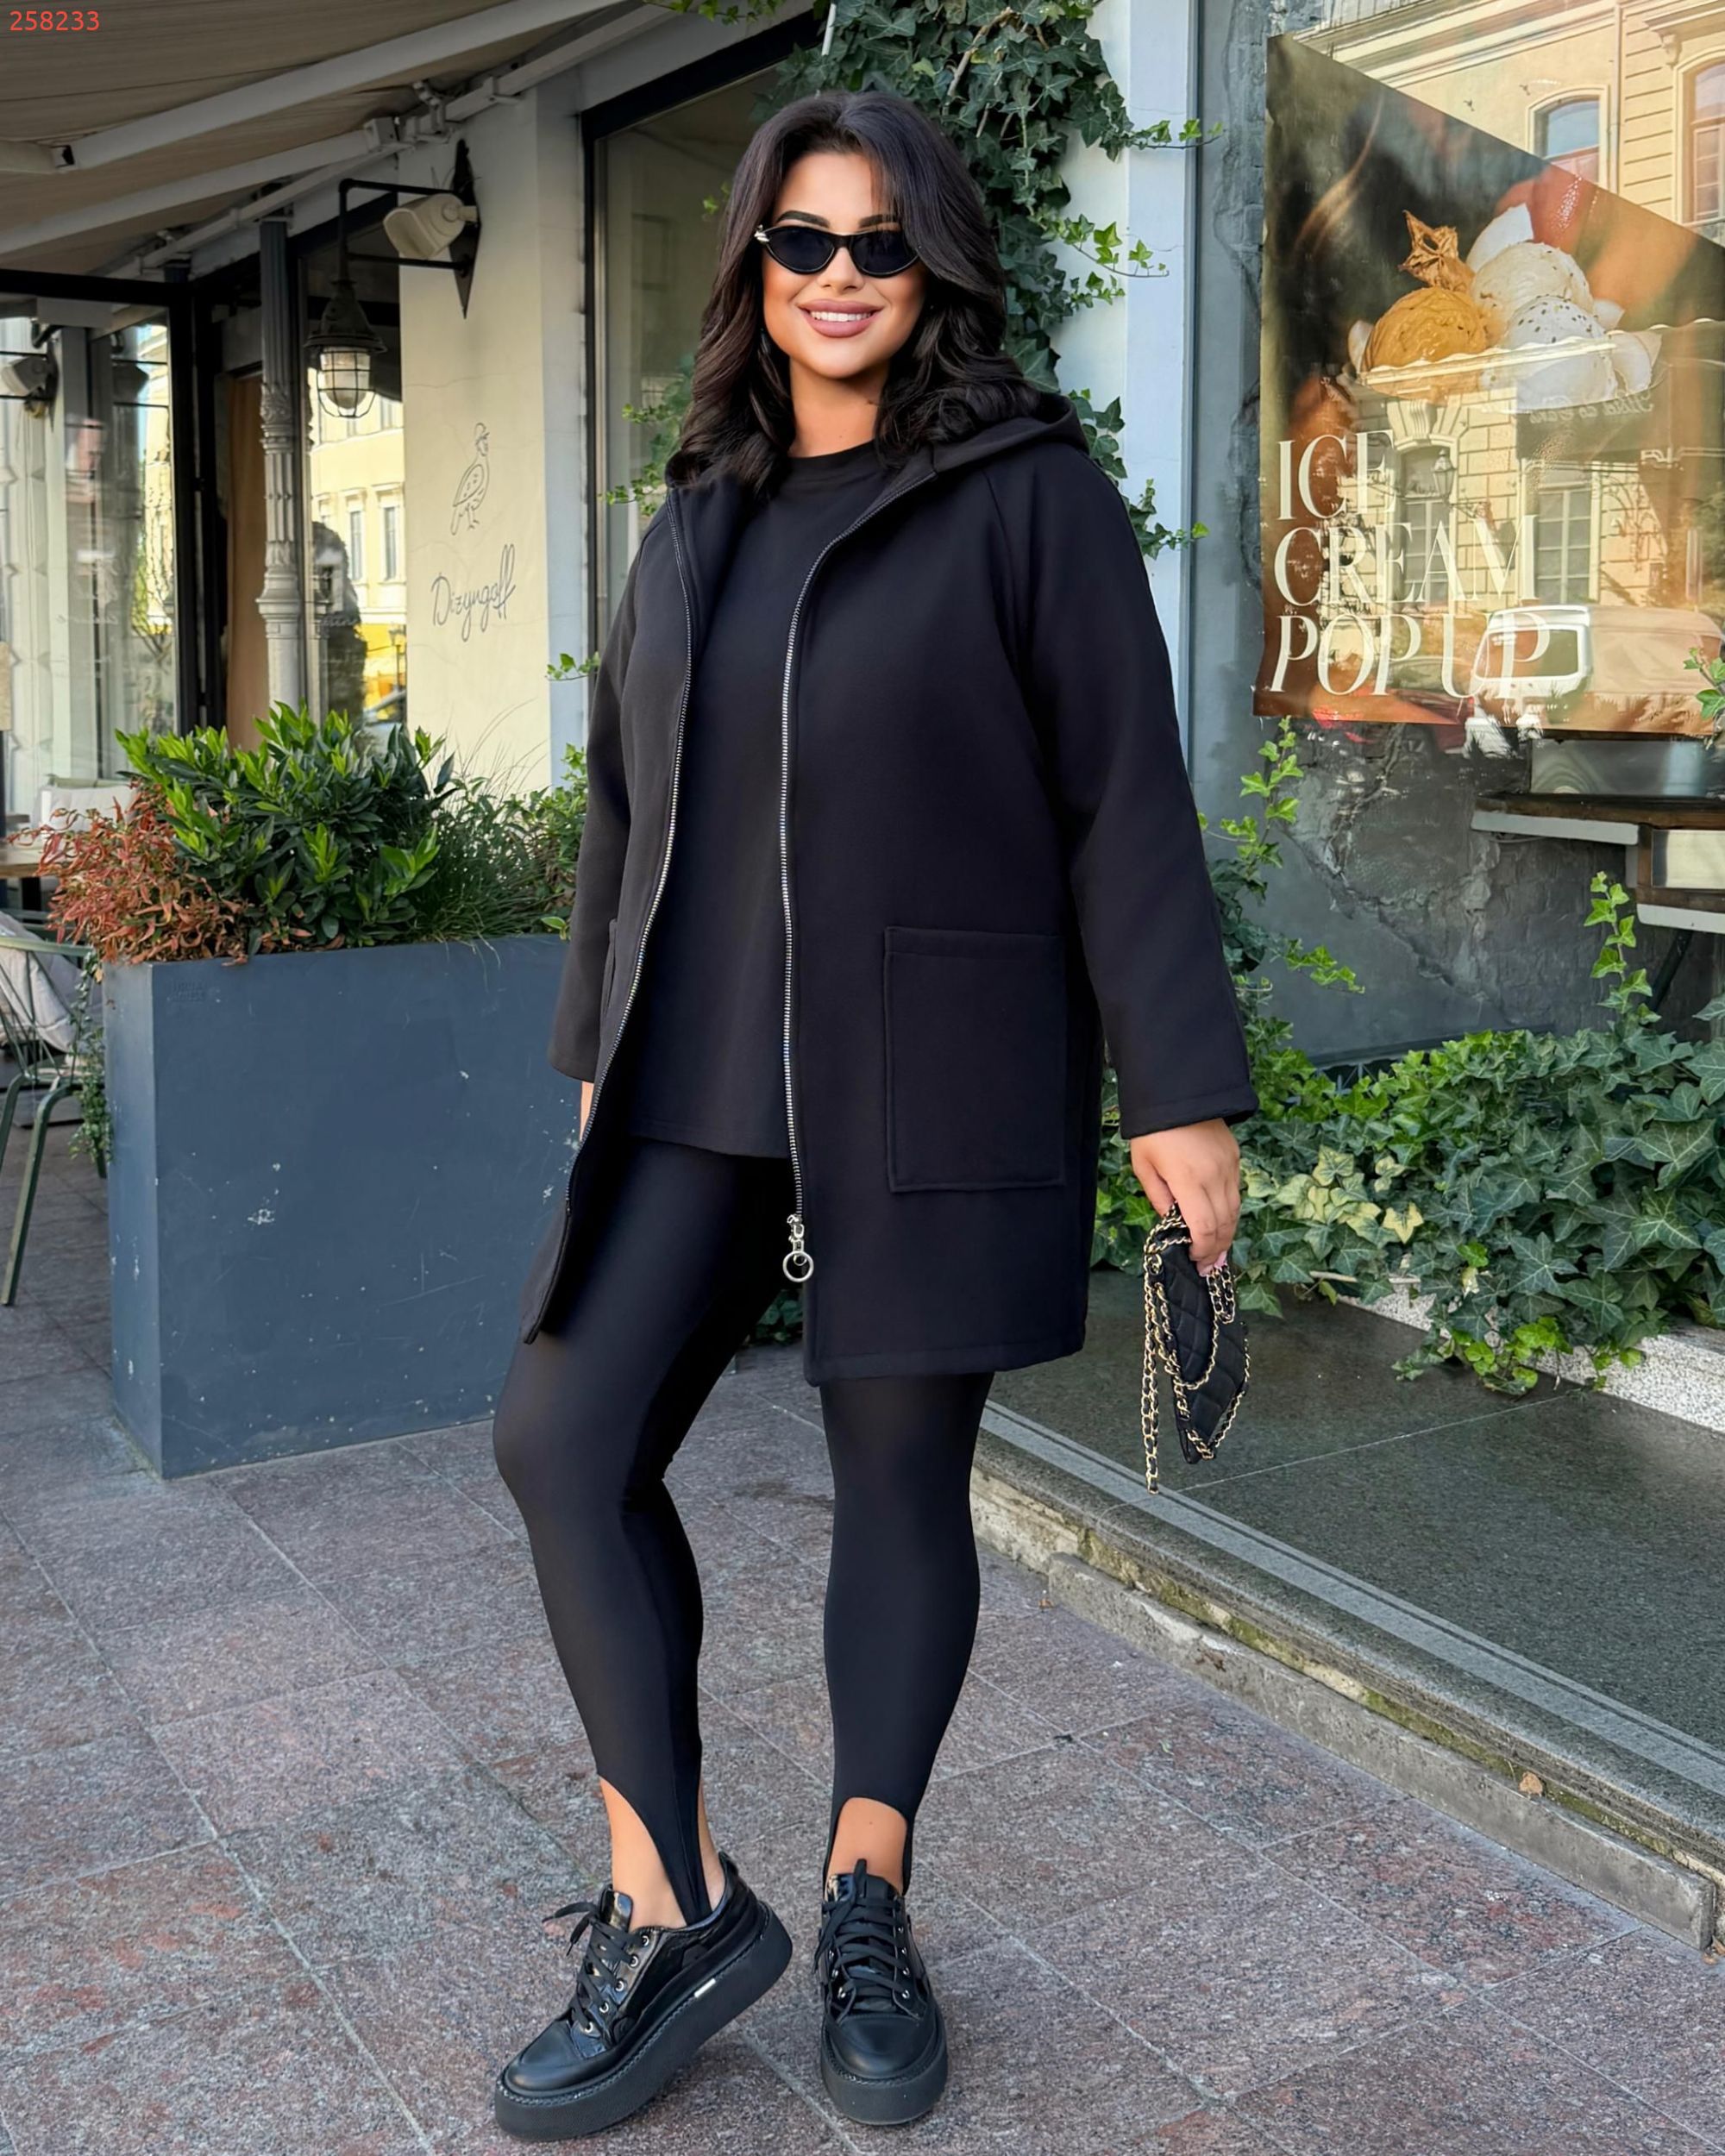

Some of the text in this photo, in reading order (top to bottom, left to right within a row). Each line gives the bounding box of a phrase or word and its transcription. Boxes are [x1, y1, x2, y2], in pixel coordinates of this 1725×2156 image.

[1277, 429, 1397, 521] ICE
[1273, 514, 1540, 607] CREAM
[1269, 612, 1551, 700] POP UP
